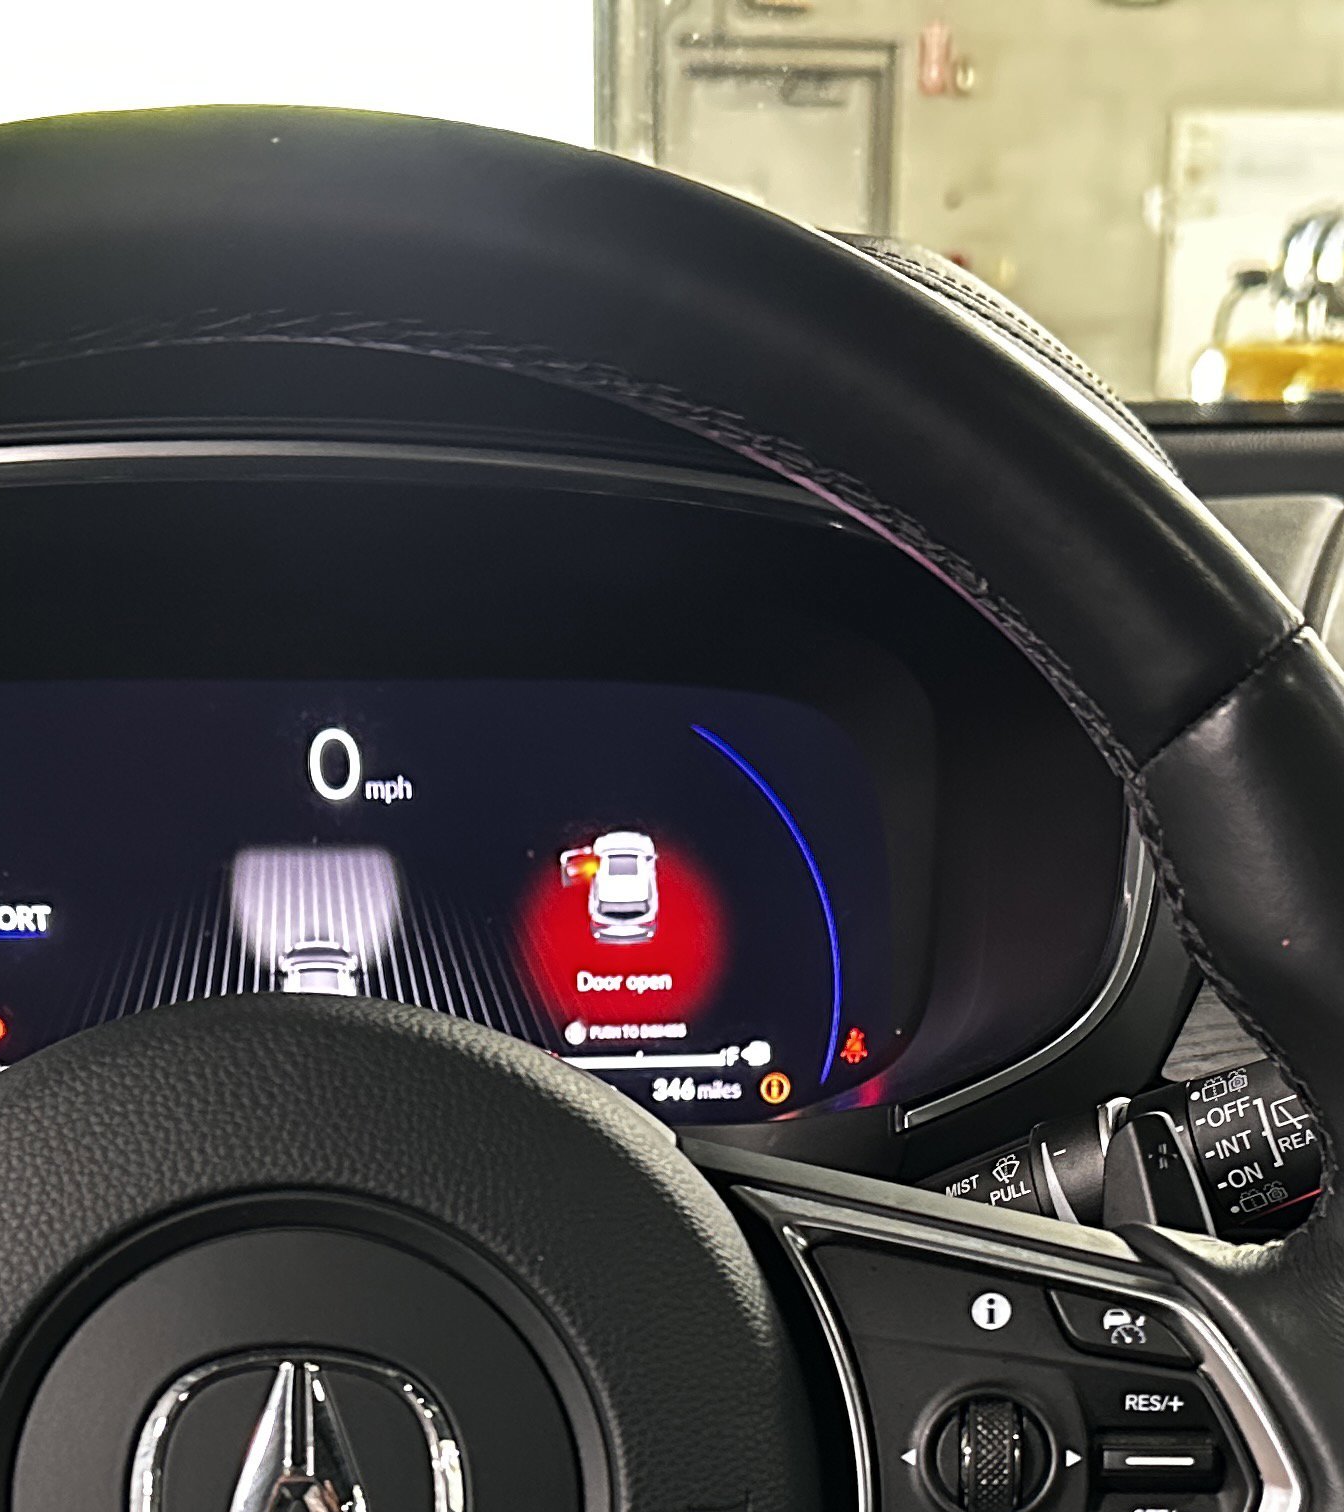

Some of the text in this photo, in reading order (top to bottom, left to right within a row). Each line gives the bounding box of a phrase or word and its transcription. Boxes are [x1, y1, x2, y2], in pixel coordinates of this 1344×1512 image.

[308, 727, 413, 804] 0 mph
[577, 971, 673, 994] Door open
[652, 1076, 742, 1101] 346 miles
[1206, 1095, 1251, 1128] OFF
[1216, 1129, 1252, 1160] INT
[1277, 1128, 1318, 1154] REA
[945, 1174, 980, 1199] MIST
[1227, 1163, 1264, 1188] ON
[989, 1182, 1032, 1206] PULL
[1124, 1394, 1185, 1412] RES/+
